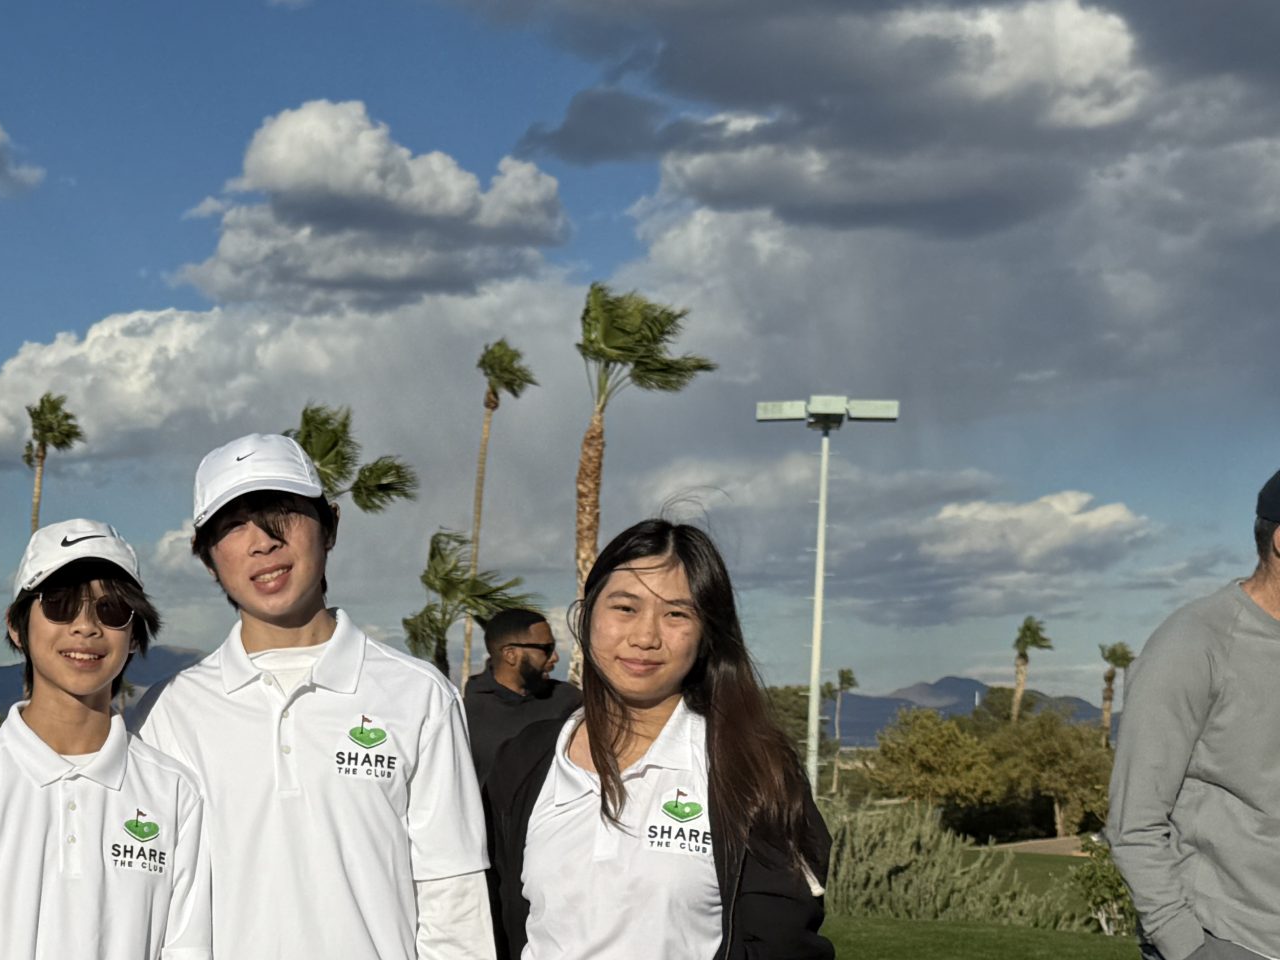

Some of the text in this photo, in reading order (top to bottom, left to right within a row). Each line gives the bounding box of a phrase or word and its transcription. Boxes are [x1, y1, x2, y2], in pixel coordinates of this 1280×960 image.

[335, 751, 397, 770] SHARE
[337, 766, 392, 779] THE CLUB
[648, 824, 713, 846] SHARE
[111, 843, 167, 866] SHARE
[649, 840, 708, 854] THE CLUB
[113, 858, 164, 874] THE CLUB
